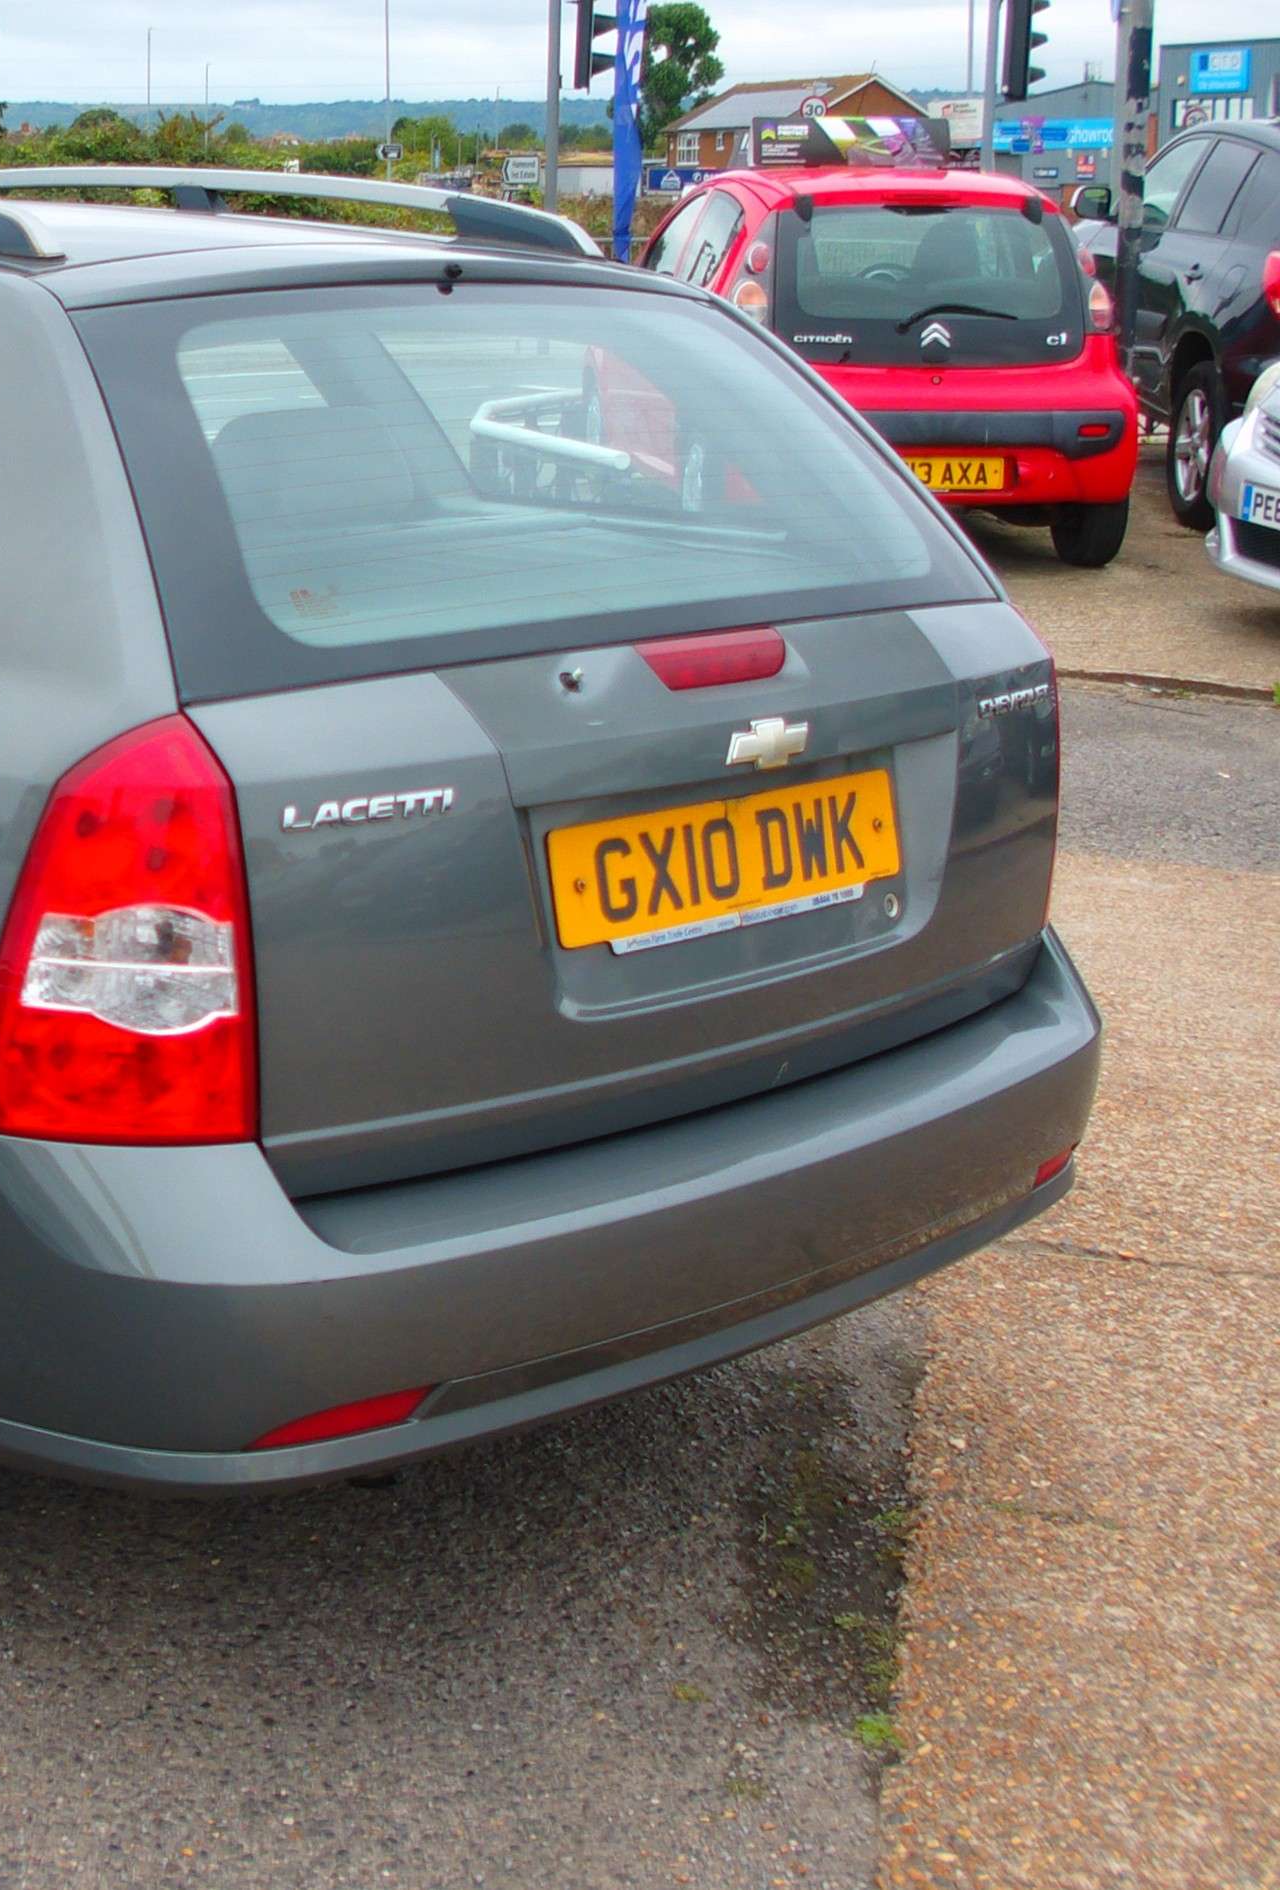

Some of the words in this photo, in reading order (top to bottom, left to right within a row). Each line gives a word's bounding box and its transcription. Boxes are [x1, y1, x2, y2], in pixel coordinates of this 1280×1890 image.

[805, 104, 824, 117] 30
[940, 462, 988, 485] AXA
[282, 786, 456, 831] LACETTI
[593, 817, 741, 924] GX10
[754, 791, 866, 892] DWK
